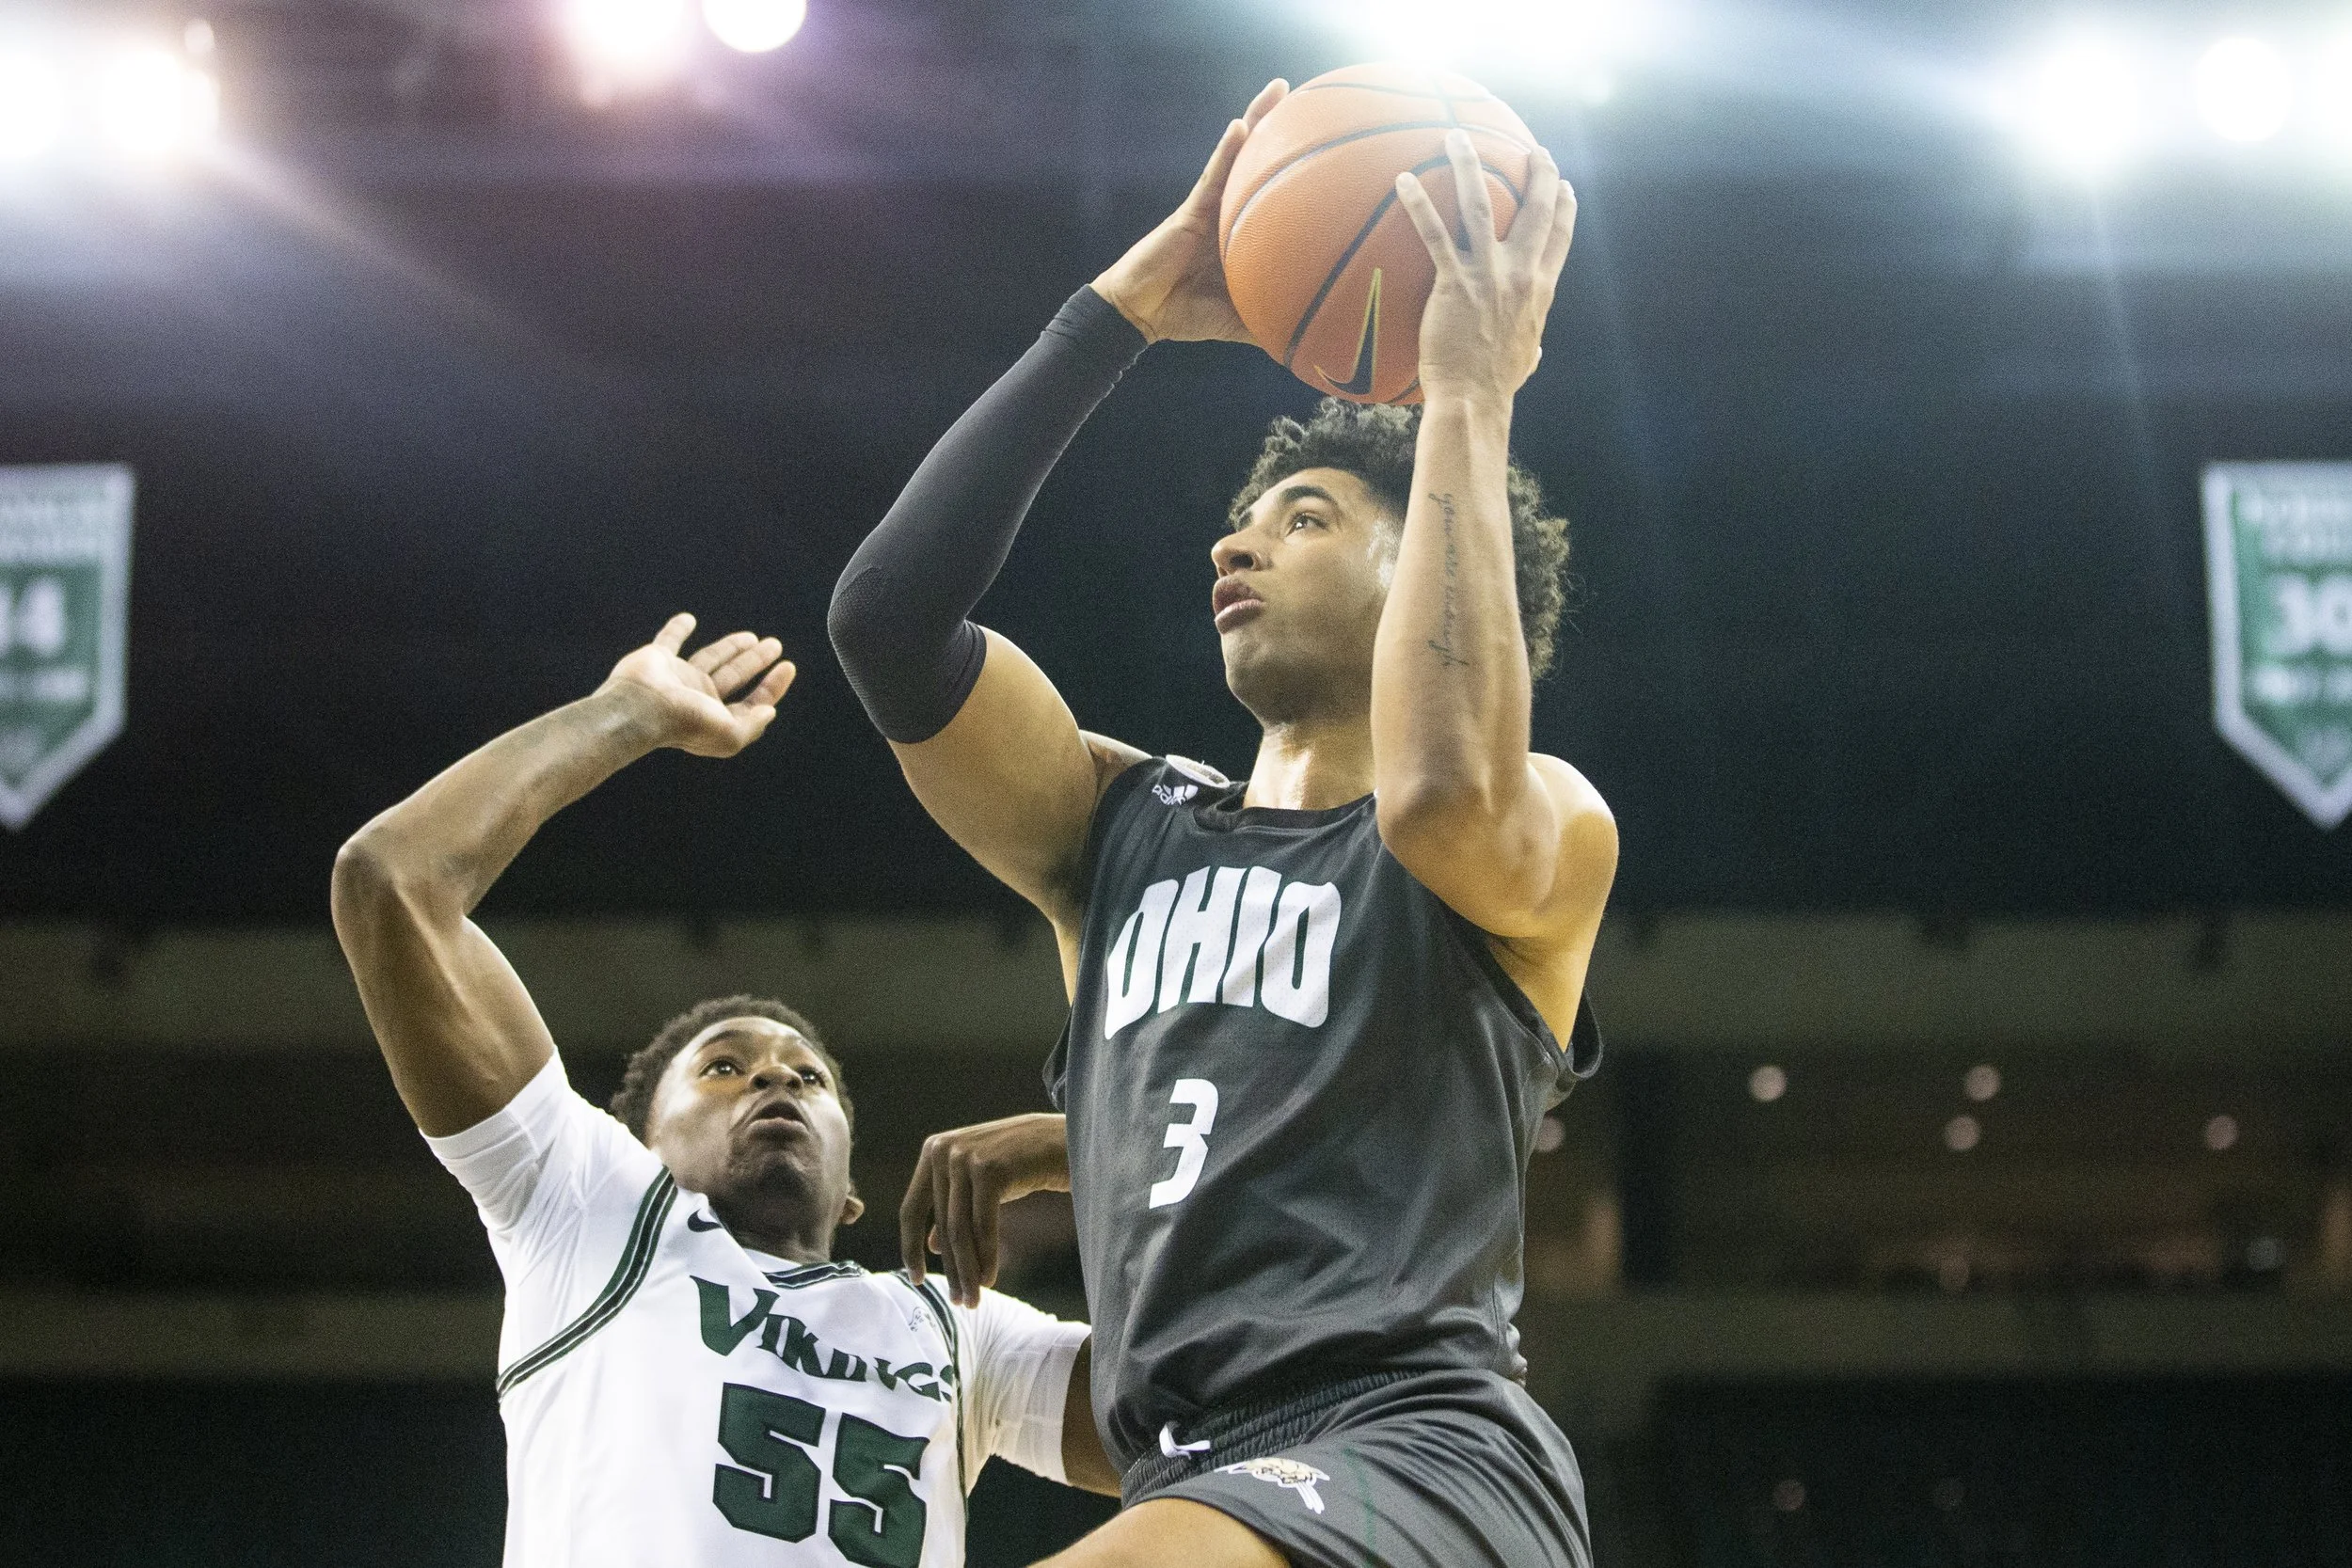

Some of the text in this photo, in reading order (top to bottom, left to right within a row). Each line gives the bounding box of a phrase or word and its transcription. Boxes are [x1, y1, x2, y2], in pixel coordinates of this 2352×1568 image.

[1104, 865, 1342, 1040] OHIO
[1149, 1078, 1219, 1210] 3
[712, 1382, 930, 1568] 55
